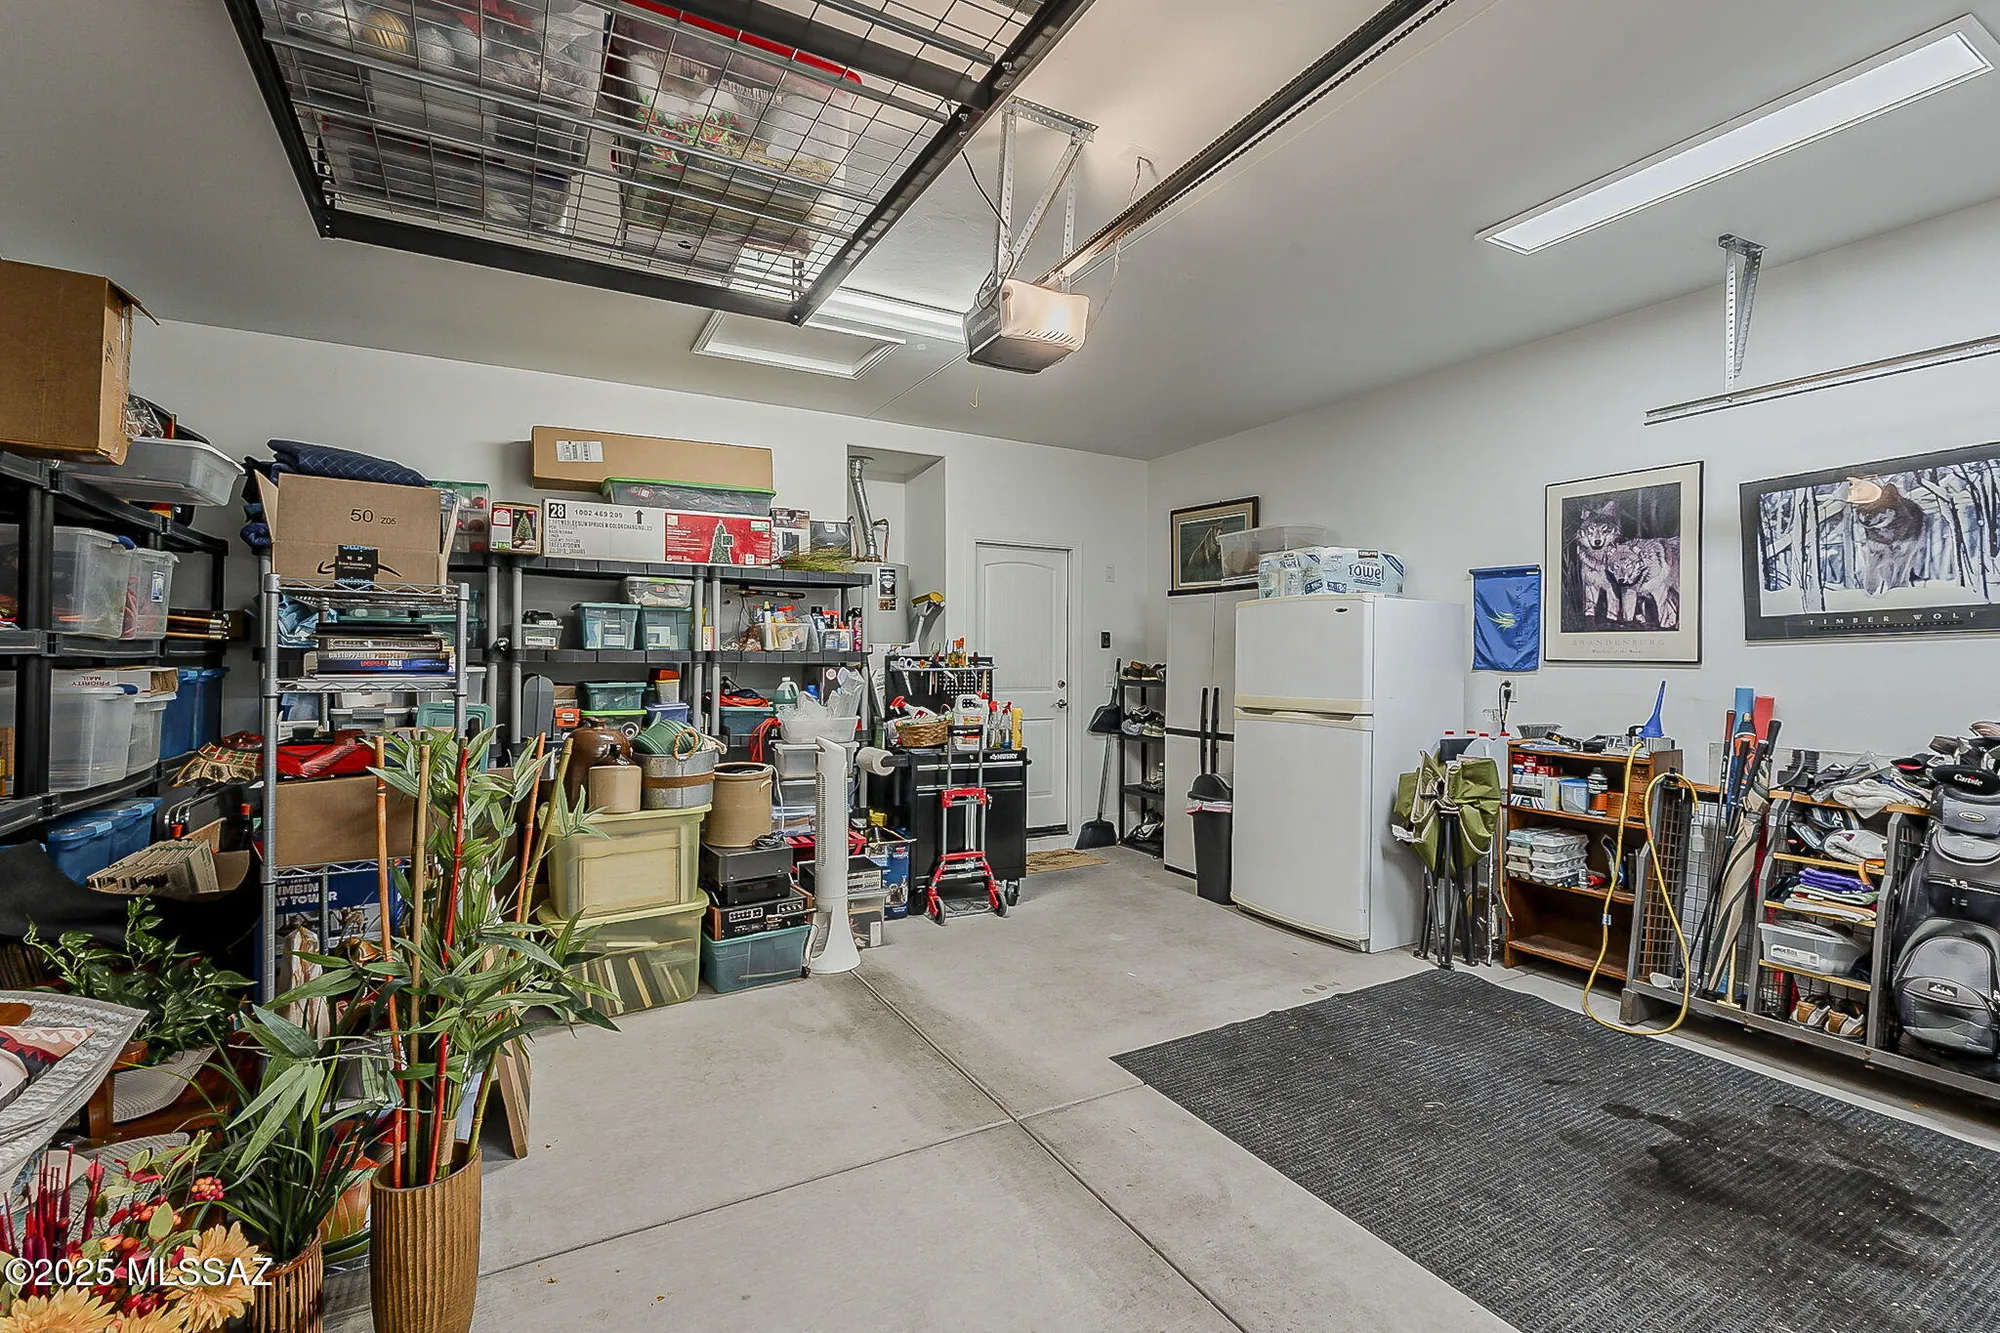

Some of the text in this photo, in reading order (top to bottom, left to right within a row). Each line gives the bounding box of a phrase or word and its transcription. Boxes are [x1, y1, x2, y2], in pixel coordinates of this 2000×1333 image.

[350, 508, 374, 523] 50
[550, 504, 564, 518] 28
[1808, 615, 1891, 626] TIMBER
[1912, 611, 1977, 622] WOLF
[290, 891, 338, 906] TOWR
